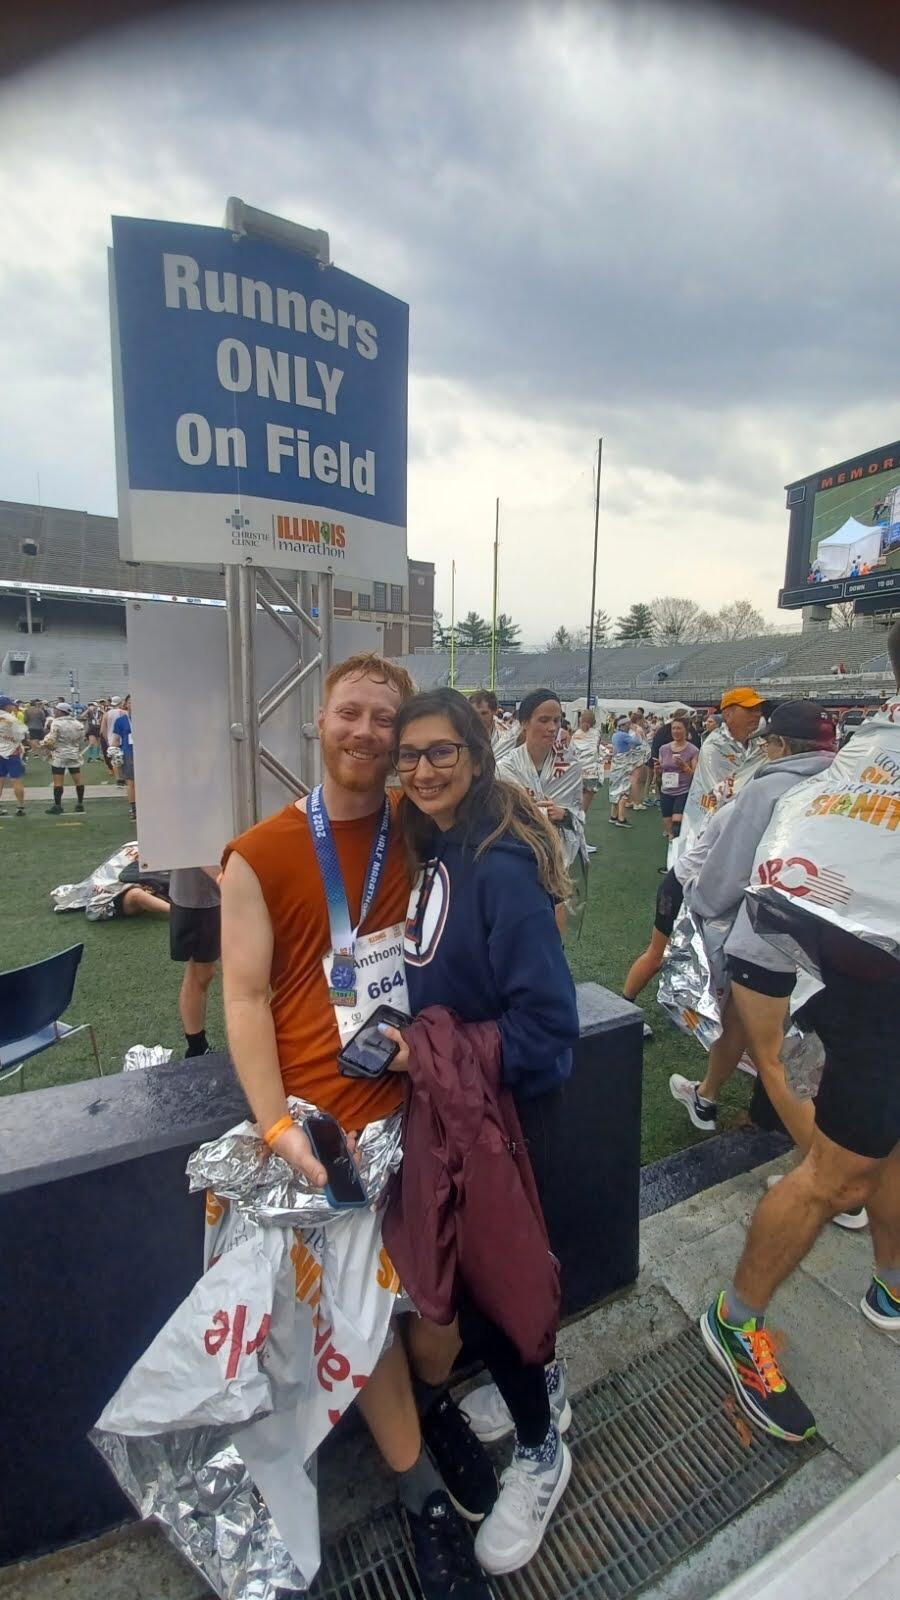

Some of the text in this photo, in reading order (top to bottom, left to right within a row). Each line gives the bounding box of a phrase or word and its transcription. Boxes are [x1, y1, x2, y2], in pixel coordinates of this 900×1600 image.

[162, 252, 378, 361] Runners
[216, 337, 344, 415] ONLY
[175, 412, 376, 497] On Field
[821, 457, 900, 489] MEMOR
[231, 539, 260, 547] CLINIC
[277, 515, 346, 548] ILLINOIS
[278, 540, 346, 559] marathon
[849, 584, 865, 592] DOWN
[313, 813, 327, 838] 2022
[375, 833, 387, 860] HALF
[361, 861, 381, 918] MARATHON
[352, 943, 403, 970] Anthony
[367, 970, 405, 1000] 664
